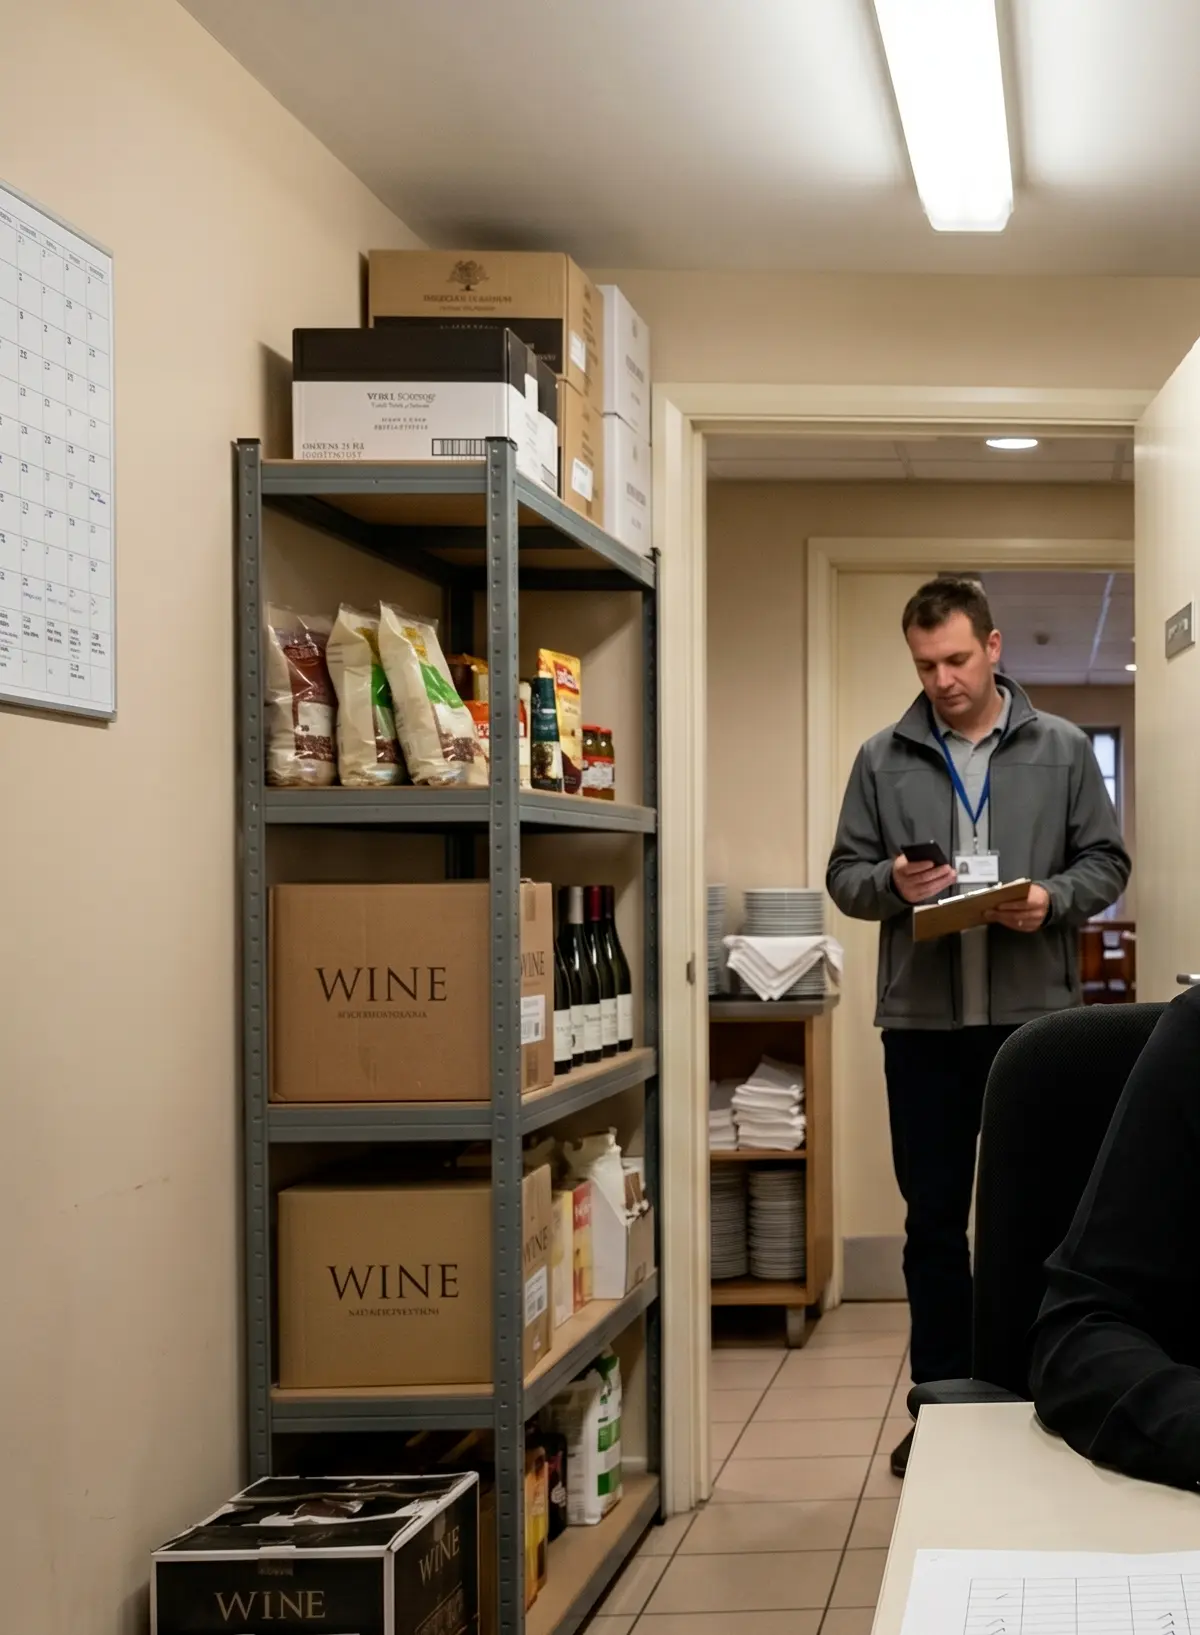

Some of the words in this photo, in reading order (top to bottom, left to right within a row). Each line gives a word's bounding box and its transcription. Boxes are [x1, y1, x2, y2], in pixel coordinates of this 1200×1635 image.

[314, 966, 448, 1003] WINE
[326, 1263, 460, 1301] WINE
[418, 1524, 461, 1587] WINE
[213, 1590, 327, 1622] WINE
